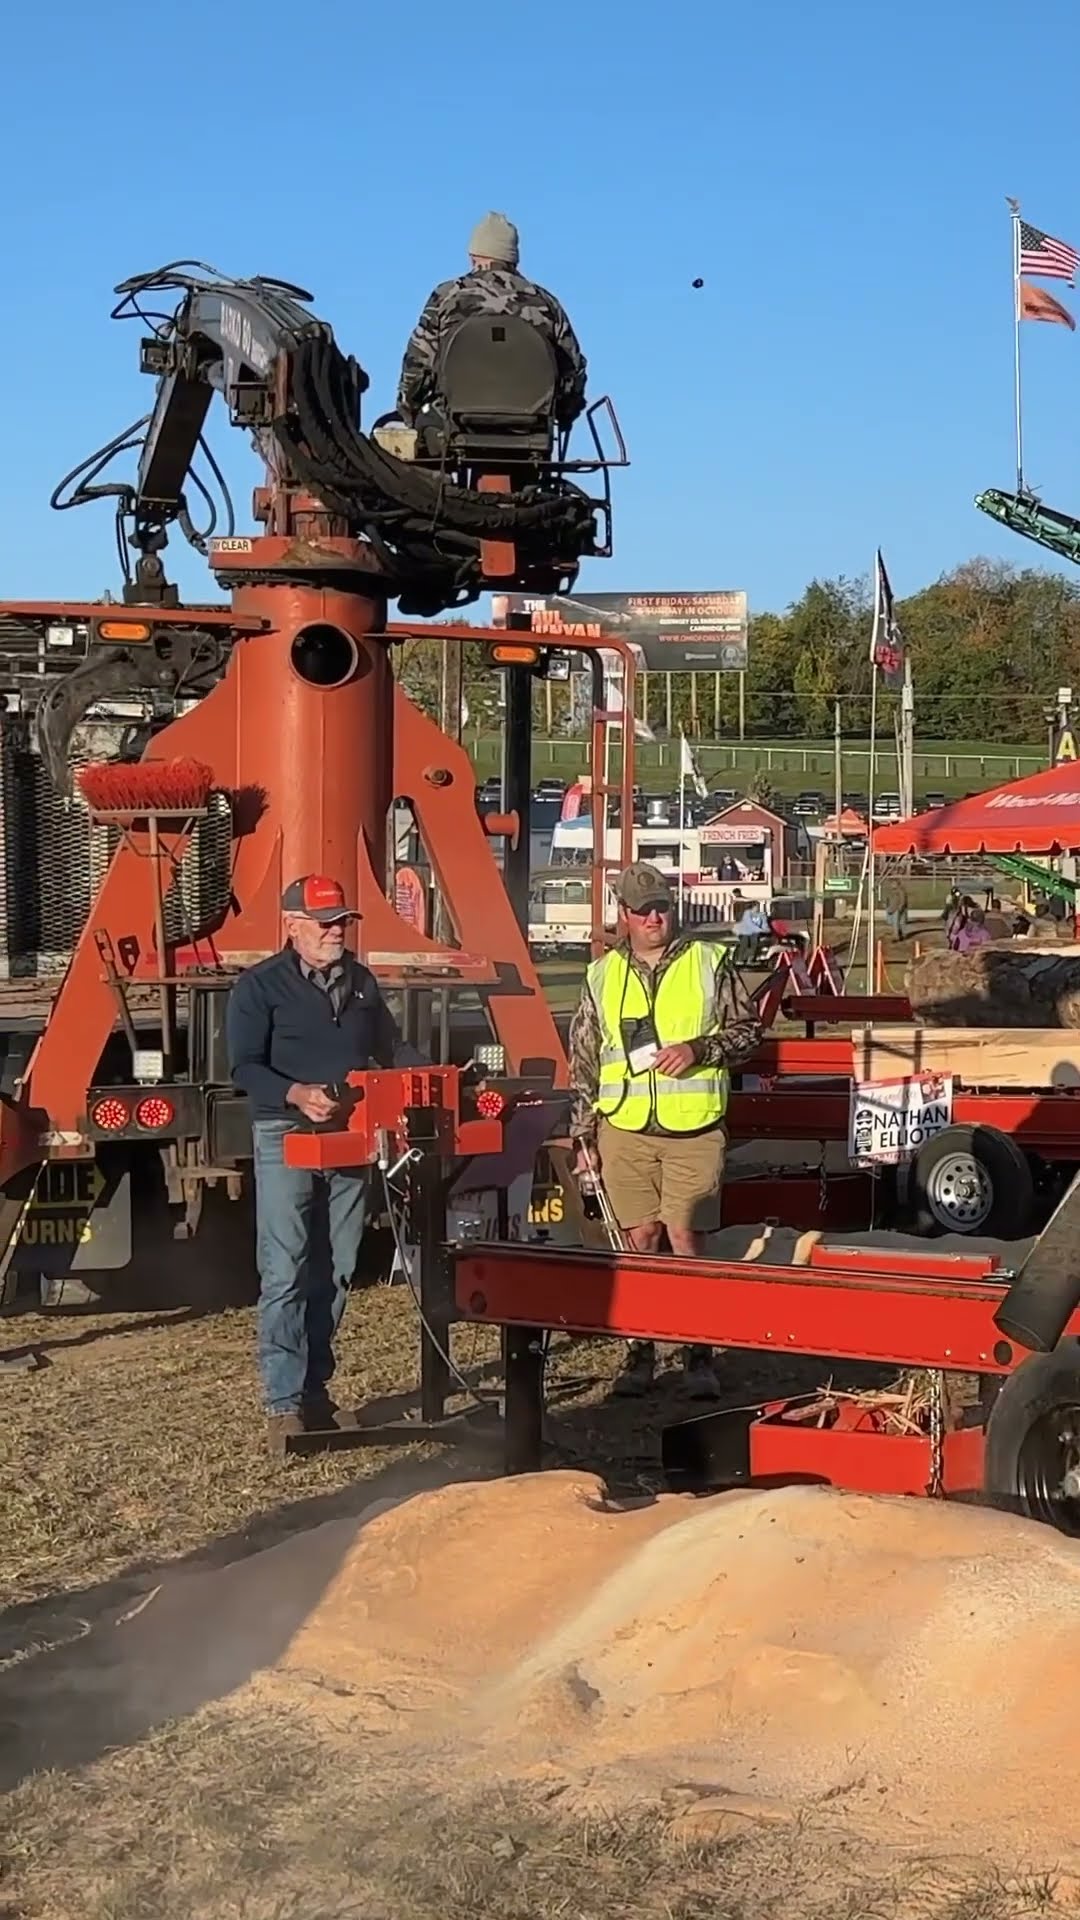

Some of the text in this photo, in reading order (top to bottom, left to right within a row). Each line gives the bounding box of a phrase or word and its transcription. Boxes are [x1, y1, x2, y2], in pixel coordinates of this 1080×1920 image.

[221, 540, 249, 550] CLEAR
[523, 600, 546, 611] THE
[628, 597, 655, 606] FIRST
[531, 610, 563, 625] AUL
[1055, 731, 1077, 760] A
[703, 830, 760, 841] FRENCH FRIES
[874, 1106, 948, 1130] NATHAN
[20, 1218, 92, 1245] URNS
